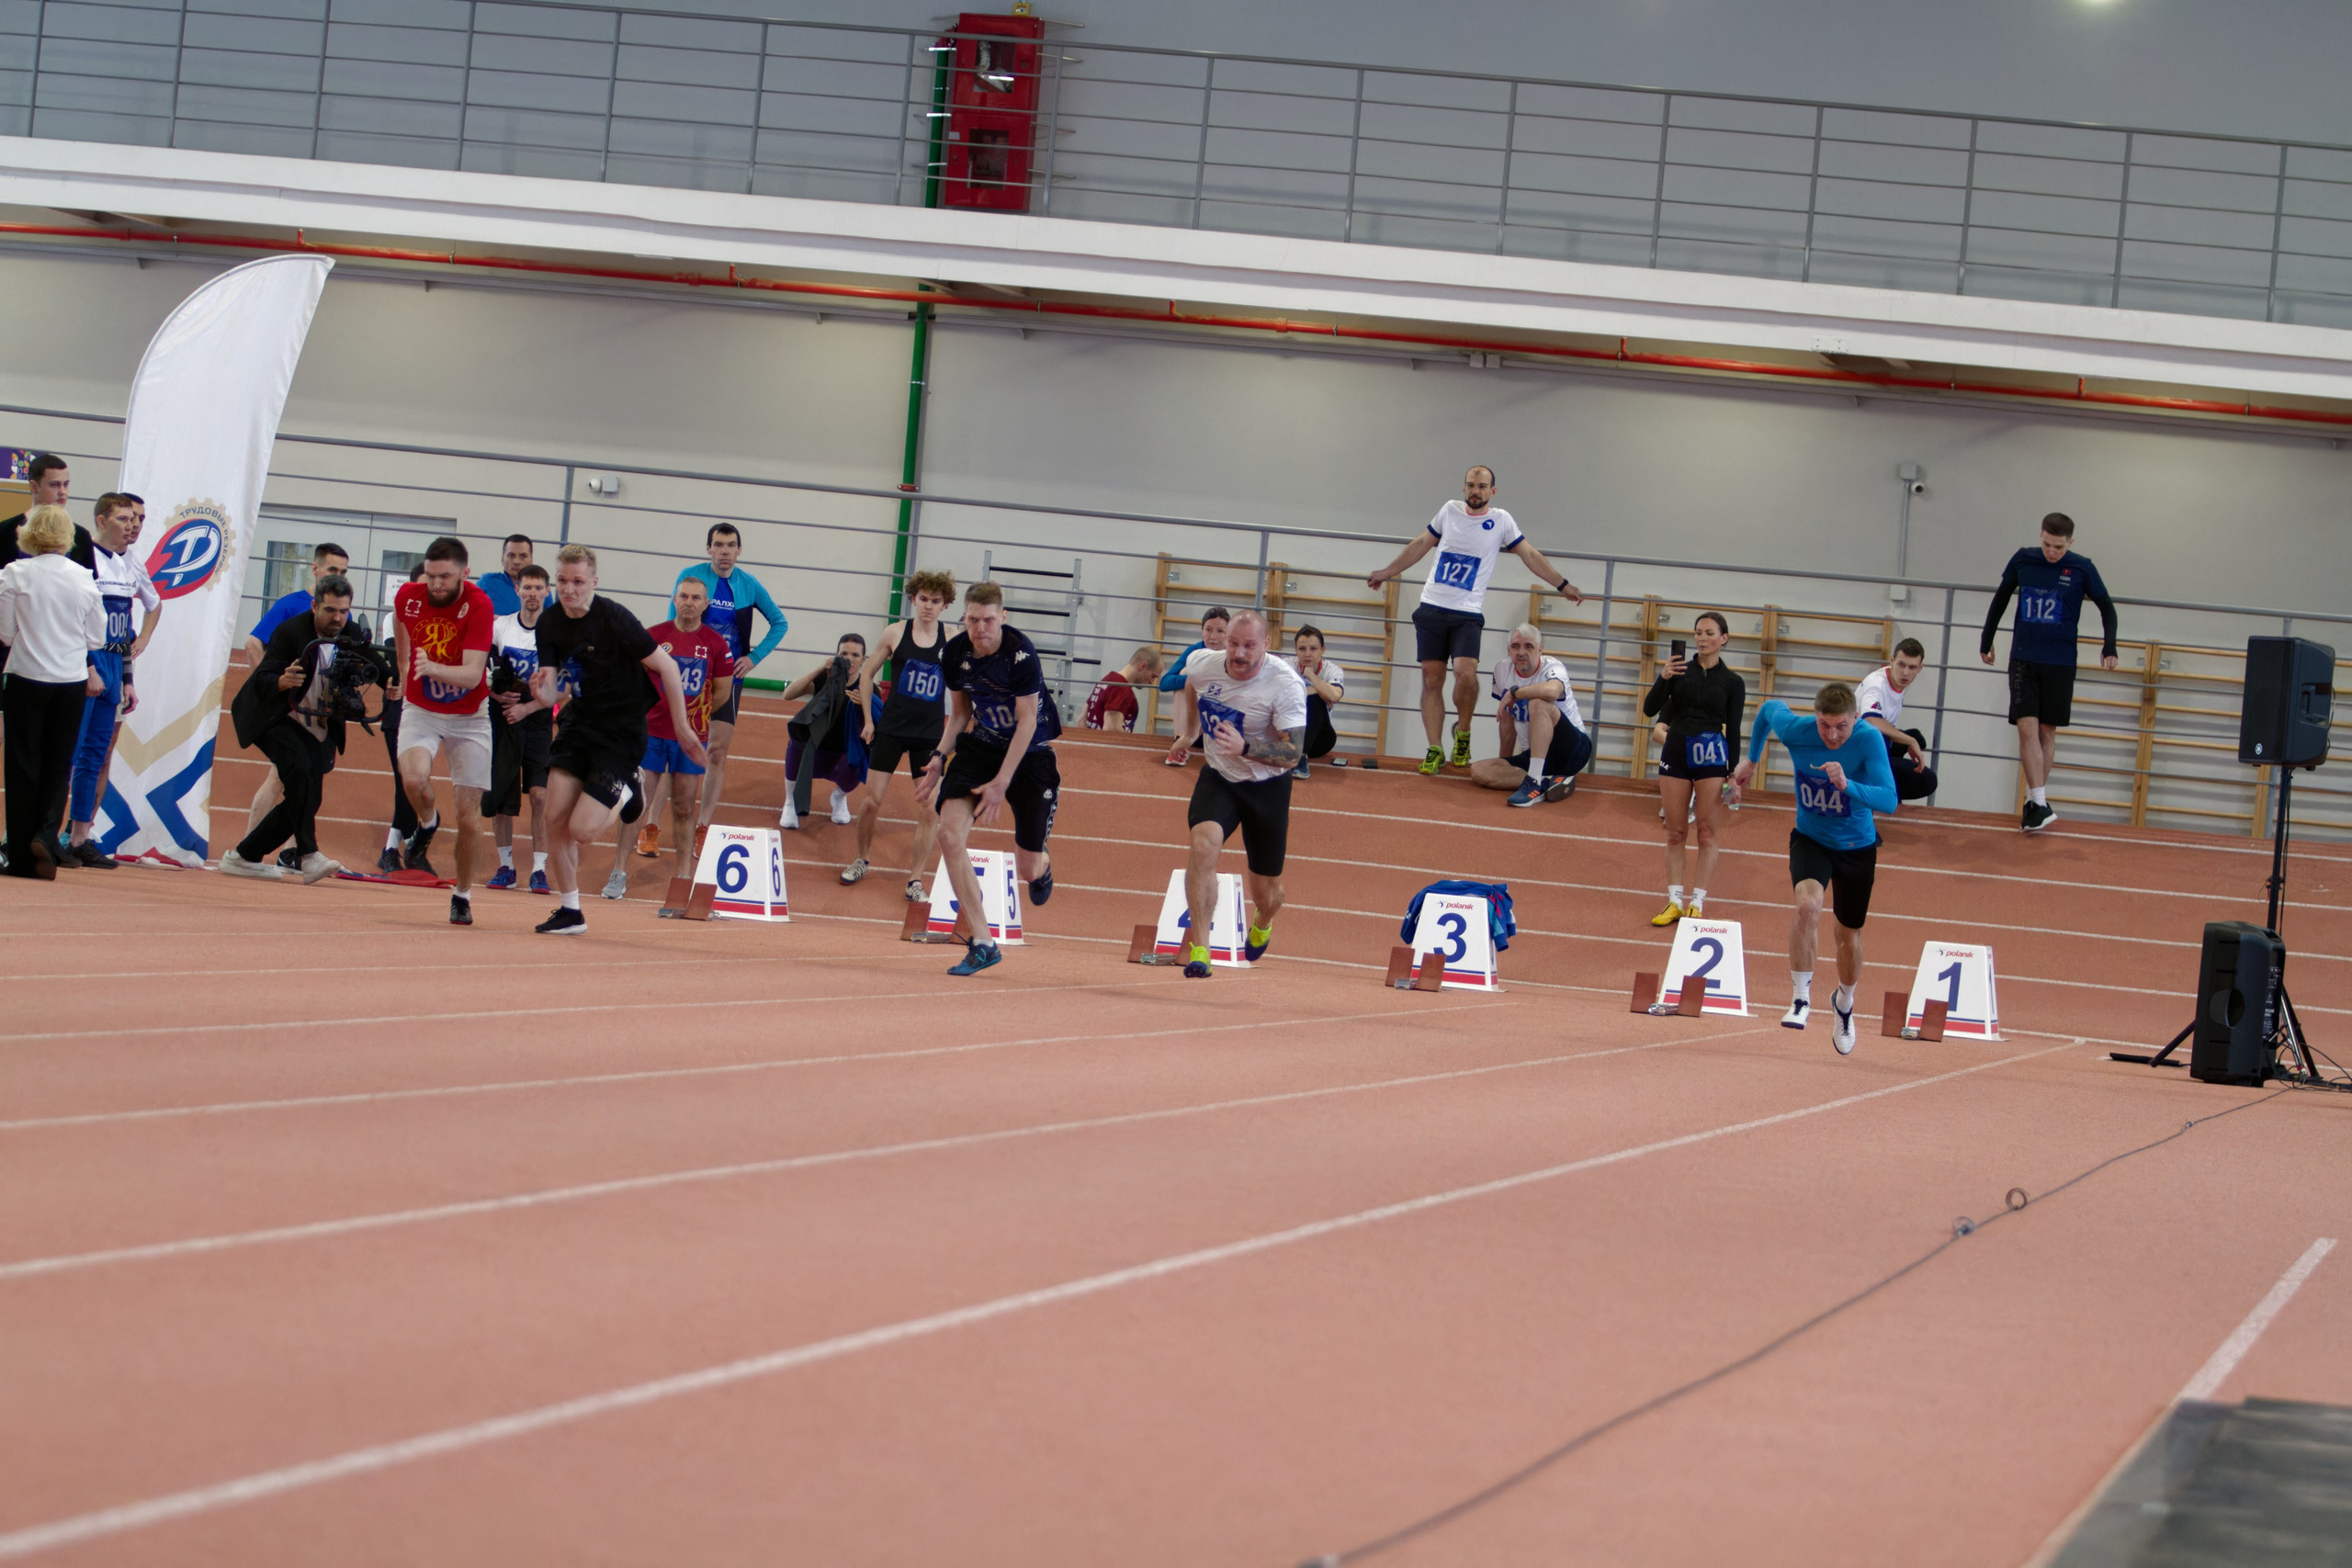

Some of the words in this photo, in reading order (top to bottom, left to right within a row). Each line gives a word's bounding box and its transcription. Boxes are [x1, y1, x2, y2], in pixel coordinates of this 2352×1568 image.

[179, 506, 226, 528] ТРУДОВЫЕ
[1442, 561, 1473, 584] 127
[711, 598, 735, 608] РАЛХ
[2026, 596, 2056, 620] 112
[429, 678, 468, 699] 04
[680, 667, 703, 692] 43
[907, 670, 939, 697] 150
[985, 705, 1018, 729] 10
[1202, 710, 1221, 733] 12
[1506, 703, 1530, 723] 31
[1692, 740, 1726, 765] 041
[1800, 783, 1844, 814] 044
[728, 832, 755, 841] polanik
[716, 843, 750, 894] 6
[969, 855, 990, 863] olanik
[772, 847, 781, 897] 6
[1007, 869, 1016, 920] 5
[1445, 901, 1474, 910] polanik
[1237, 891, 1244, 942] 4
[1433, 912, 1467, 963] 3
[1700, 924, 1728, 934] polanik
[1690, 937, 1724, 989] 2
[1946, 950, 1973, 958] polanik
[1938, 962, 1962, 1012] 1
